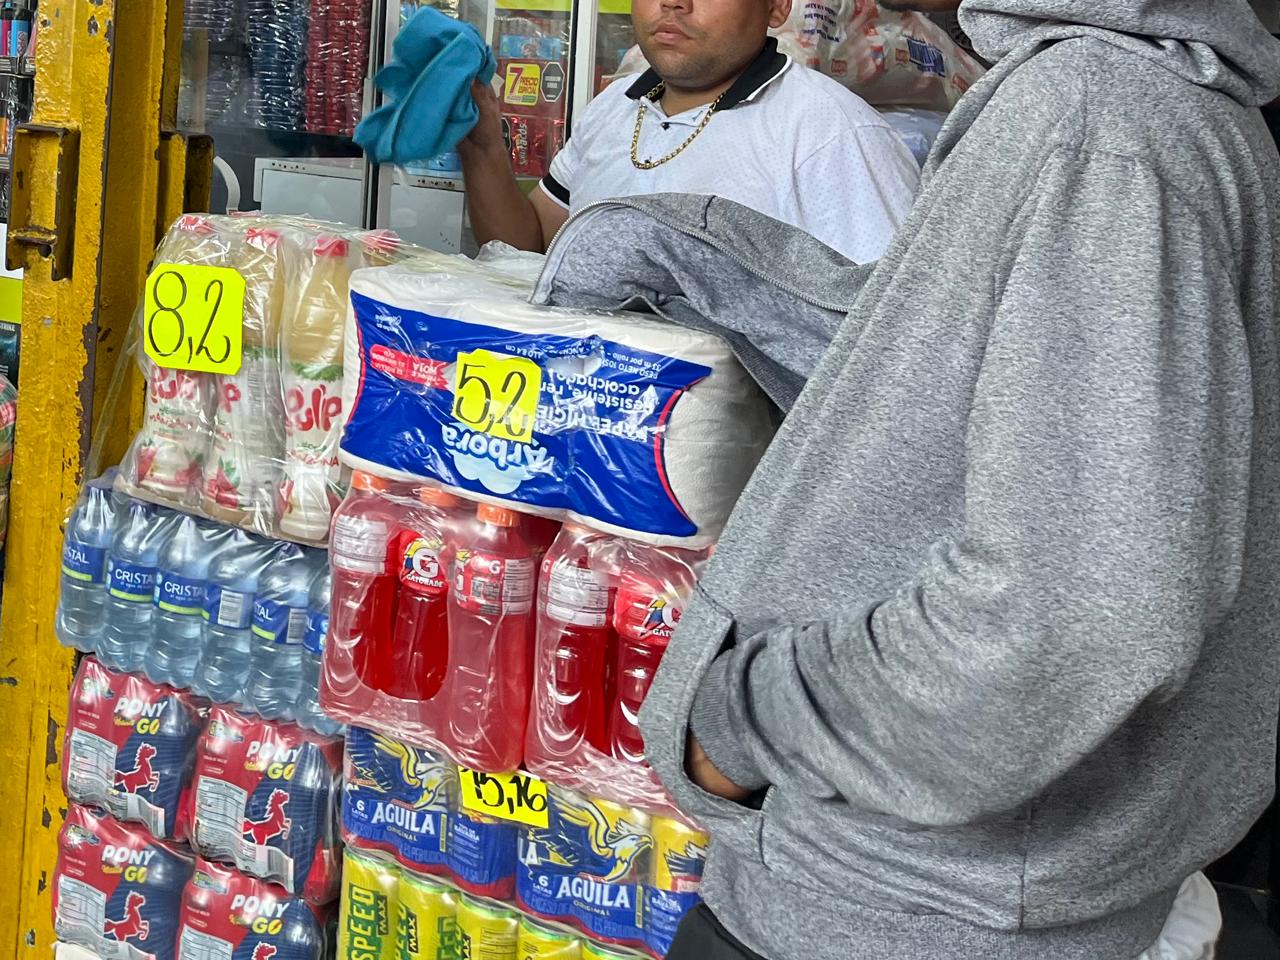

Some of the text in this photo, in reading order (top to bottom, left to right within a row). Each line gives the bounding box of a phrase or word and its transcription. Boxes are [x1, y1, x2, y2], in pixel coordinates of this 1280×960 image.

[509, 66, 524, 97] 7
[148, 270, 232, 365] 8,2
[455, 363, 528, 438] 5,2
[441, 424, 549, 470] Arbora
[406, 574, 444, 588] GATORADE
[114, 697, 169, 718] PONY
[136, 719, 161, 735] GO
[246, 740, 303, 763] PONY
[267, 763, 296, 780] GO
[356, 799, 366, 811] 6
[371, 801, 435, 836] AGUILA
[386, 825, 418, 842] ORIGINAL
[100, 844, 156, 867] PONY
[124, 865, 149, 884] GO
[538, 875, 548, 887] 6
[556, 876, 631, 909] AGUILA
[230, 894, 291, 917] PONY
[379, 899, 387, 933] MAX
[573, 899, 611, 917] ORIGINAL
[251, 917, 283, 936] GO
[350, 886, 377, 960] SPEED
[408, 916, 417, 951] MAX
